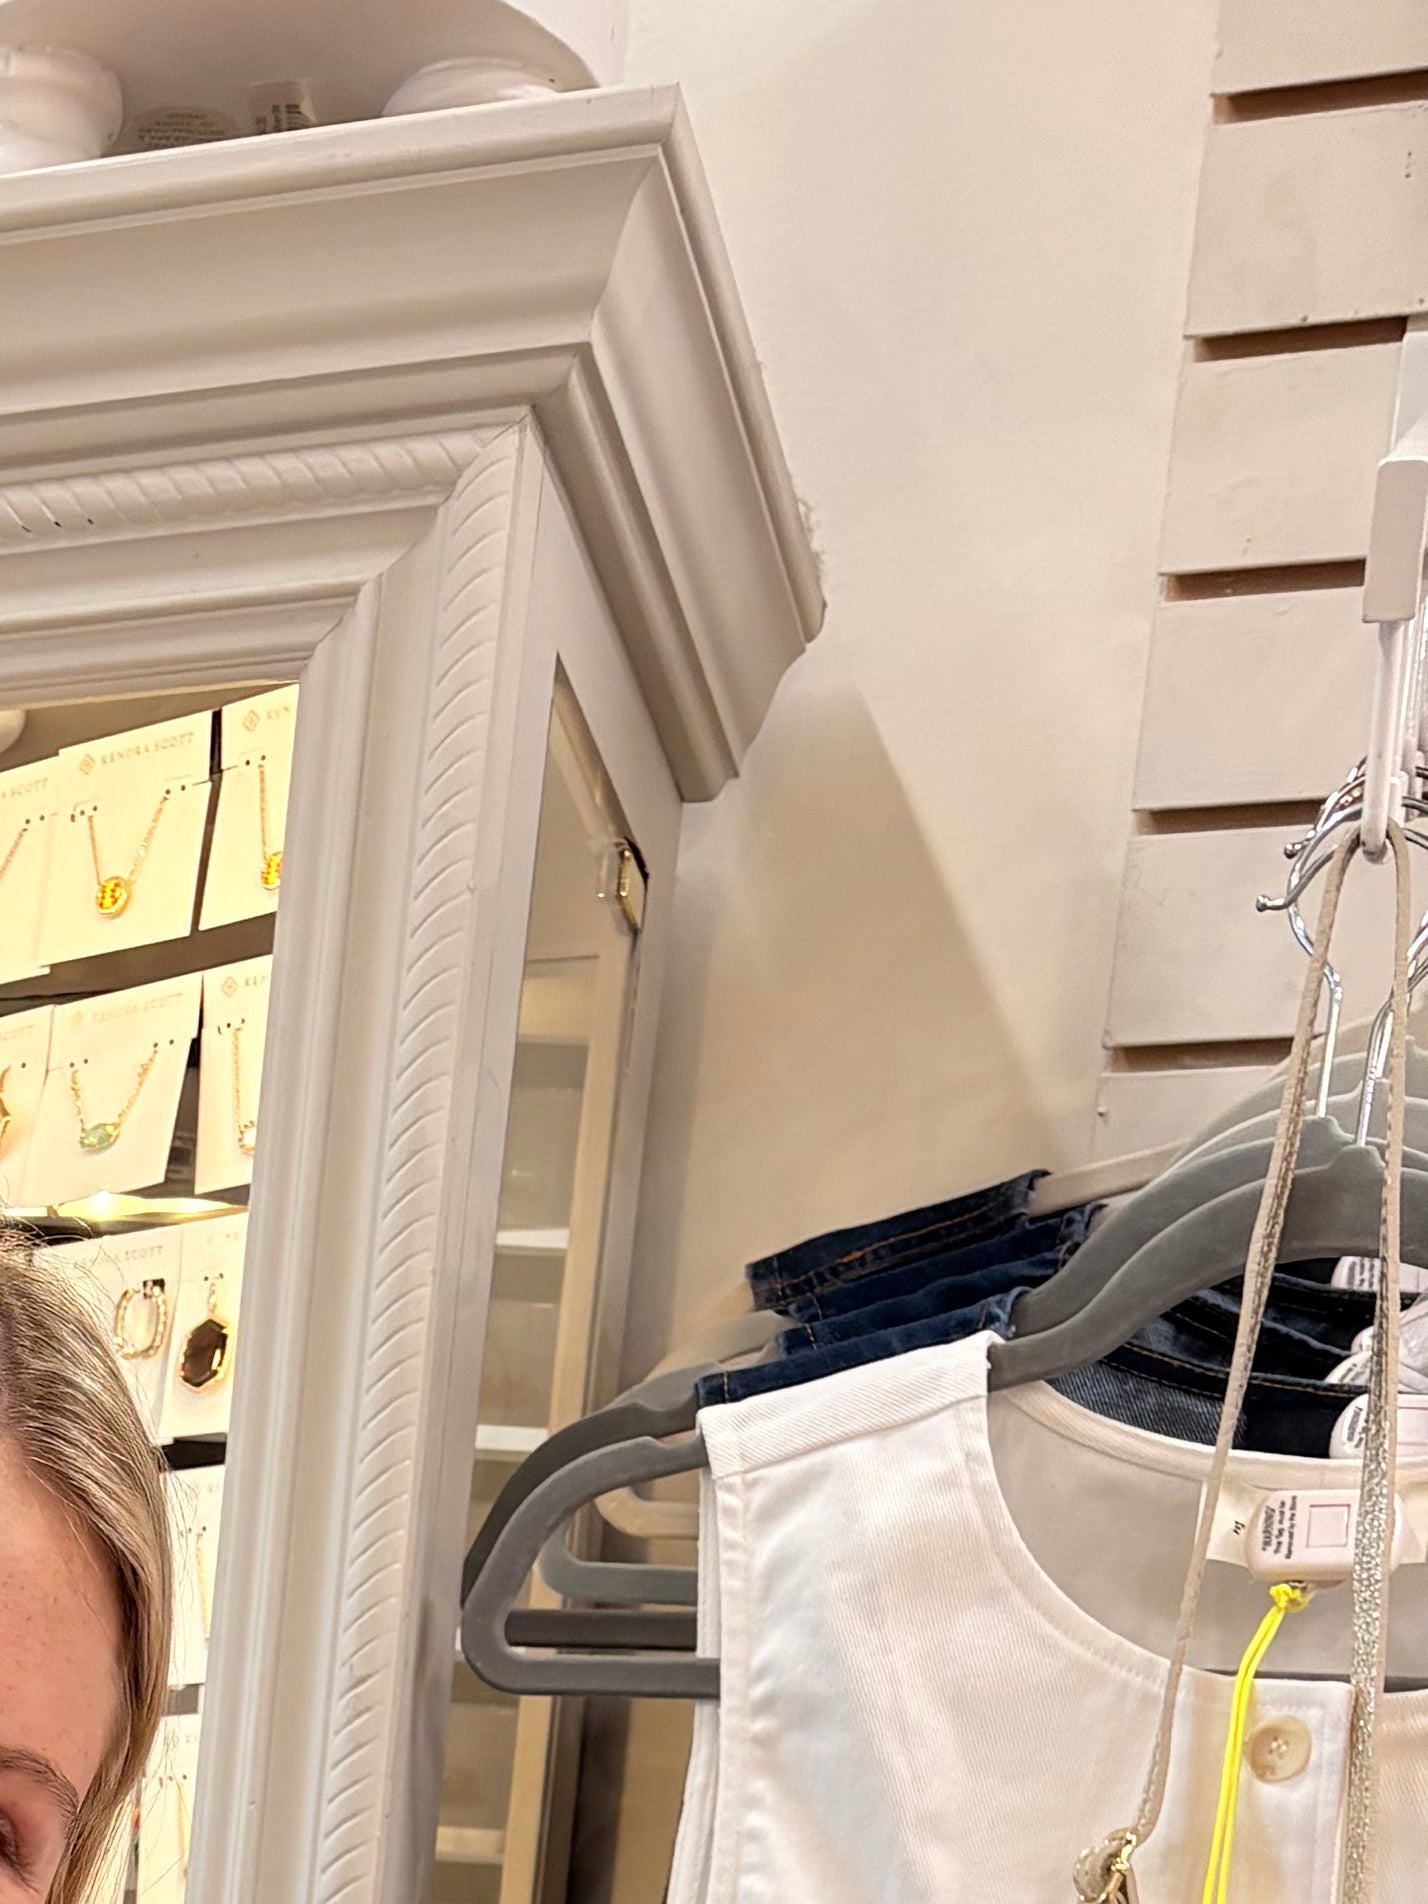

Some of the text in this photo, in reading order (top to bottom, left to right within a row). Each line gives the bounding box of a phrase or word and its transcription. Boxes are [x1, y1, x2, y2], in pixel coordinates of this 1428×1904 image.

[101, 732, 194, 765] KENDRA SCOTT
[11, 777, 48, 797] SCOTT
